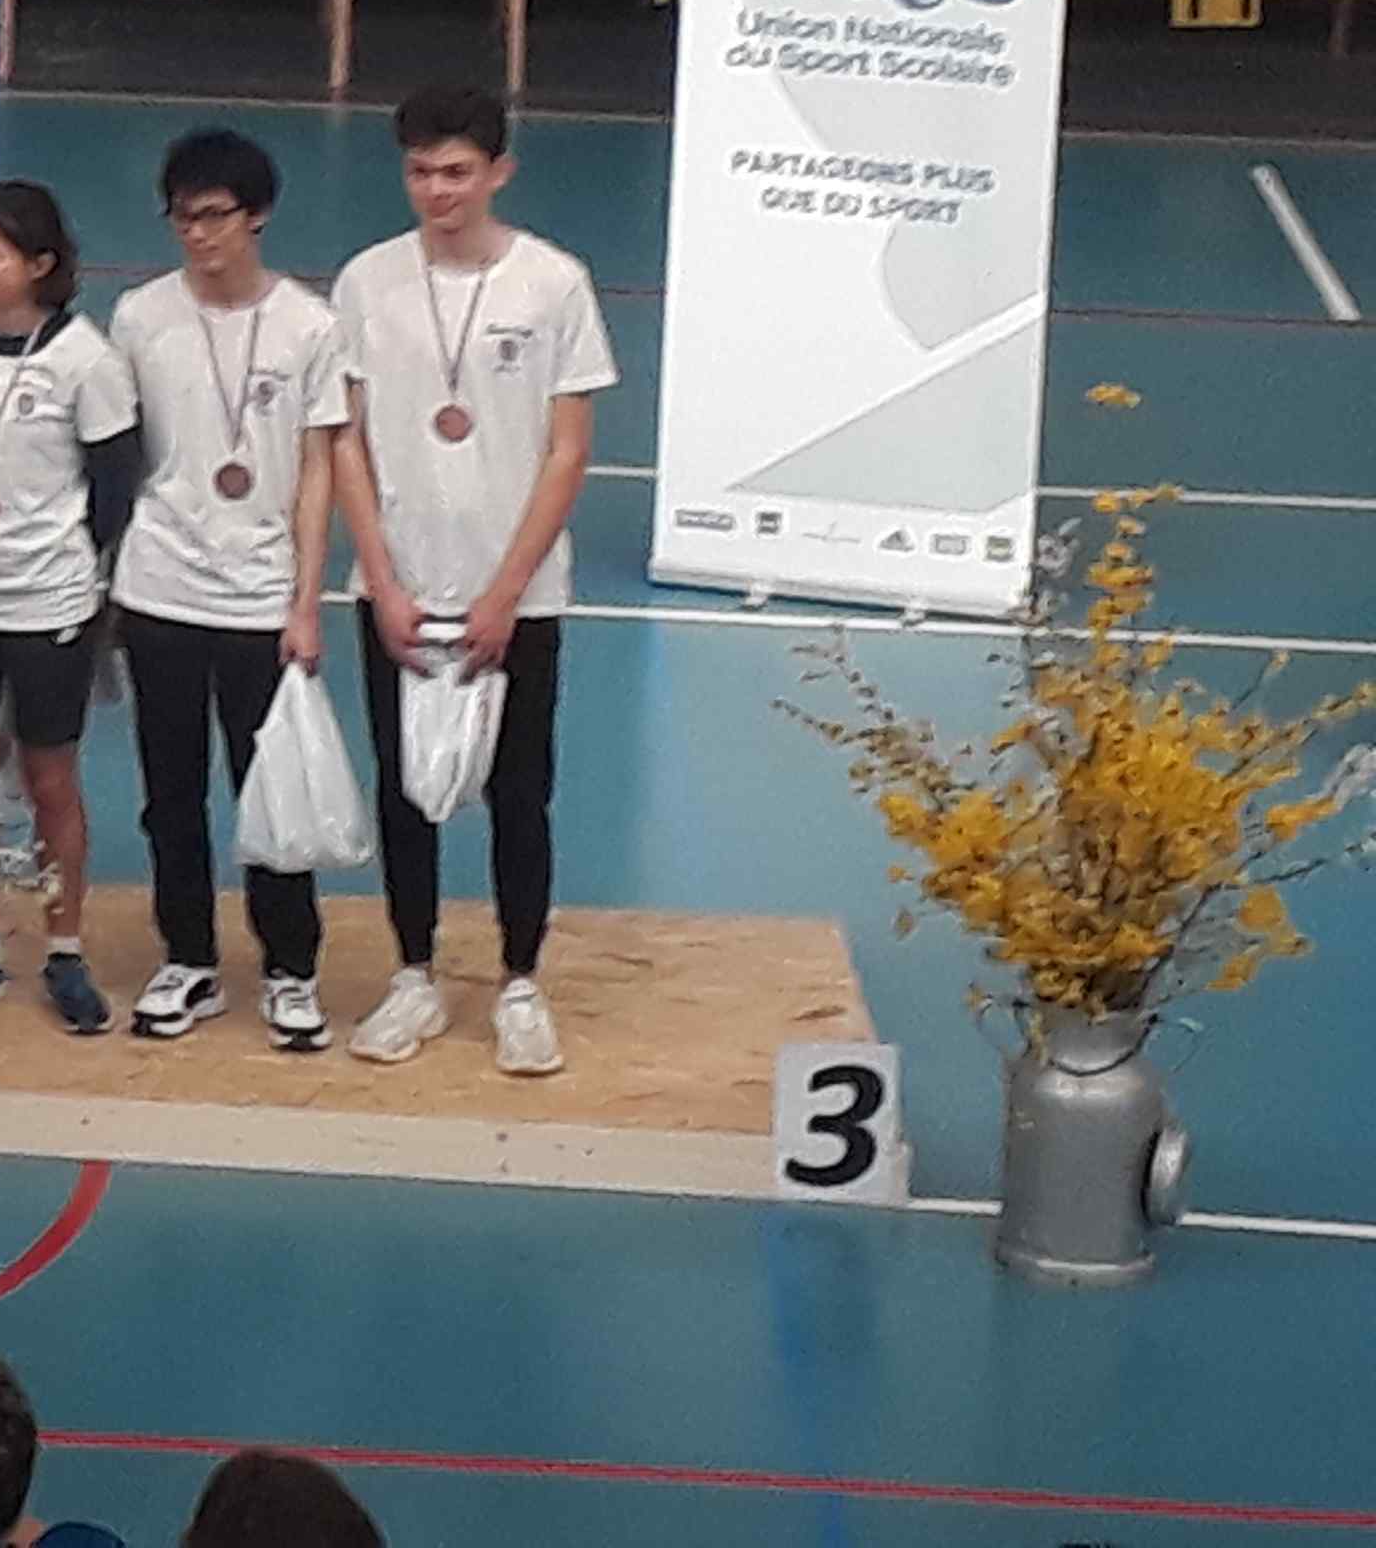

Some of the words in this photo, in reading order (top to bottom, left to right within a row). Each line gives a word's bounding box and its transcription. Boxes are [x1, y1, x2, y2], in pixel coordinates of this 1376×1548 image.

[736, 9, 837, 42] Union
[845, 16, 1009, 55] Nationale
[725, 42, 773, 68] du
[778, 44, 872, 76] Sport
[878, 51, 1018, 87] Scolaire
[731, 150, 914, 185] PARTAGEONS
[920, 164, 996, 192] PLUS
[761, 186, 816, 213] QUE
[823, 192, 863, 216] DU
[866, 196, 962, 224] SPORT
[785, 1065, 885, 1187] 3
